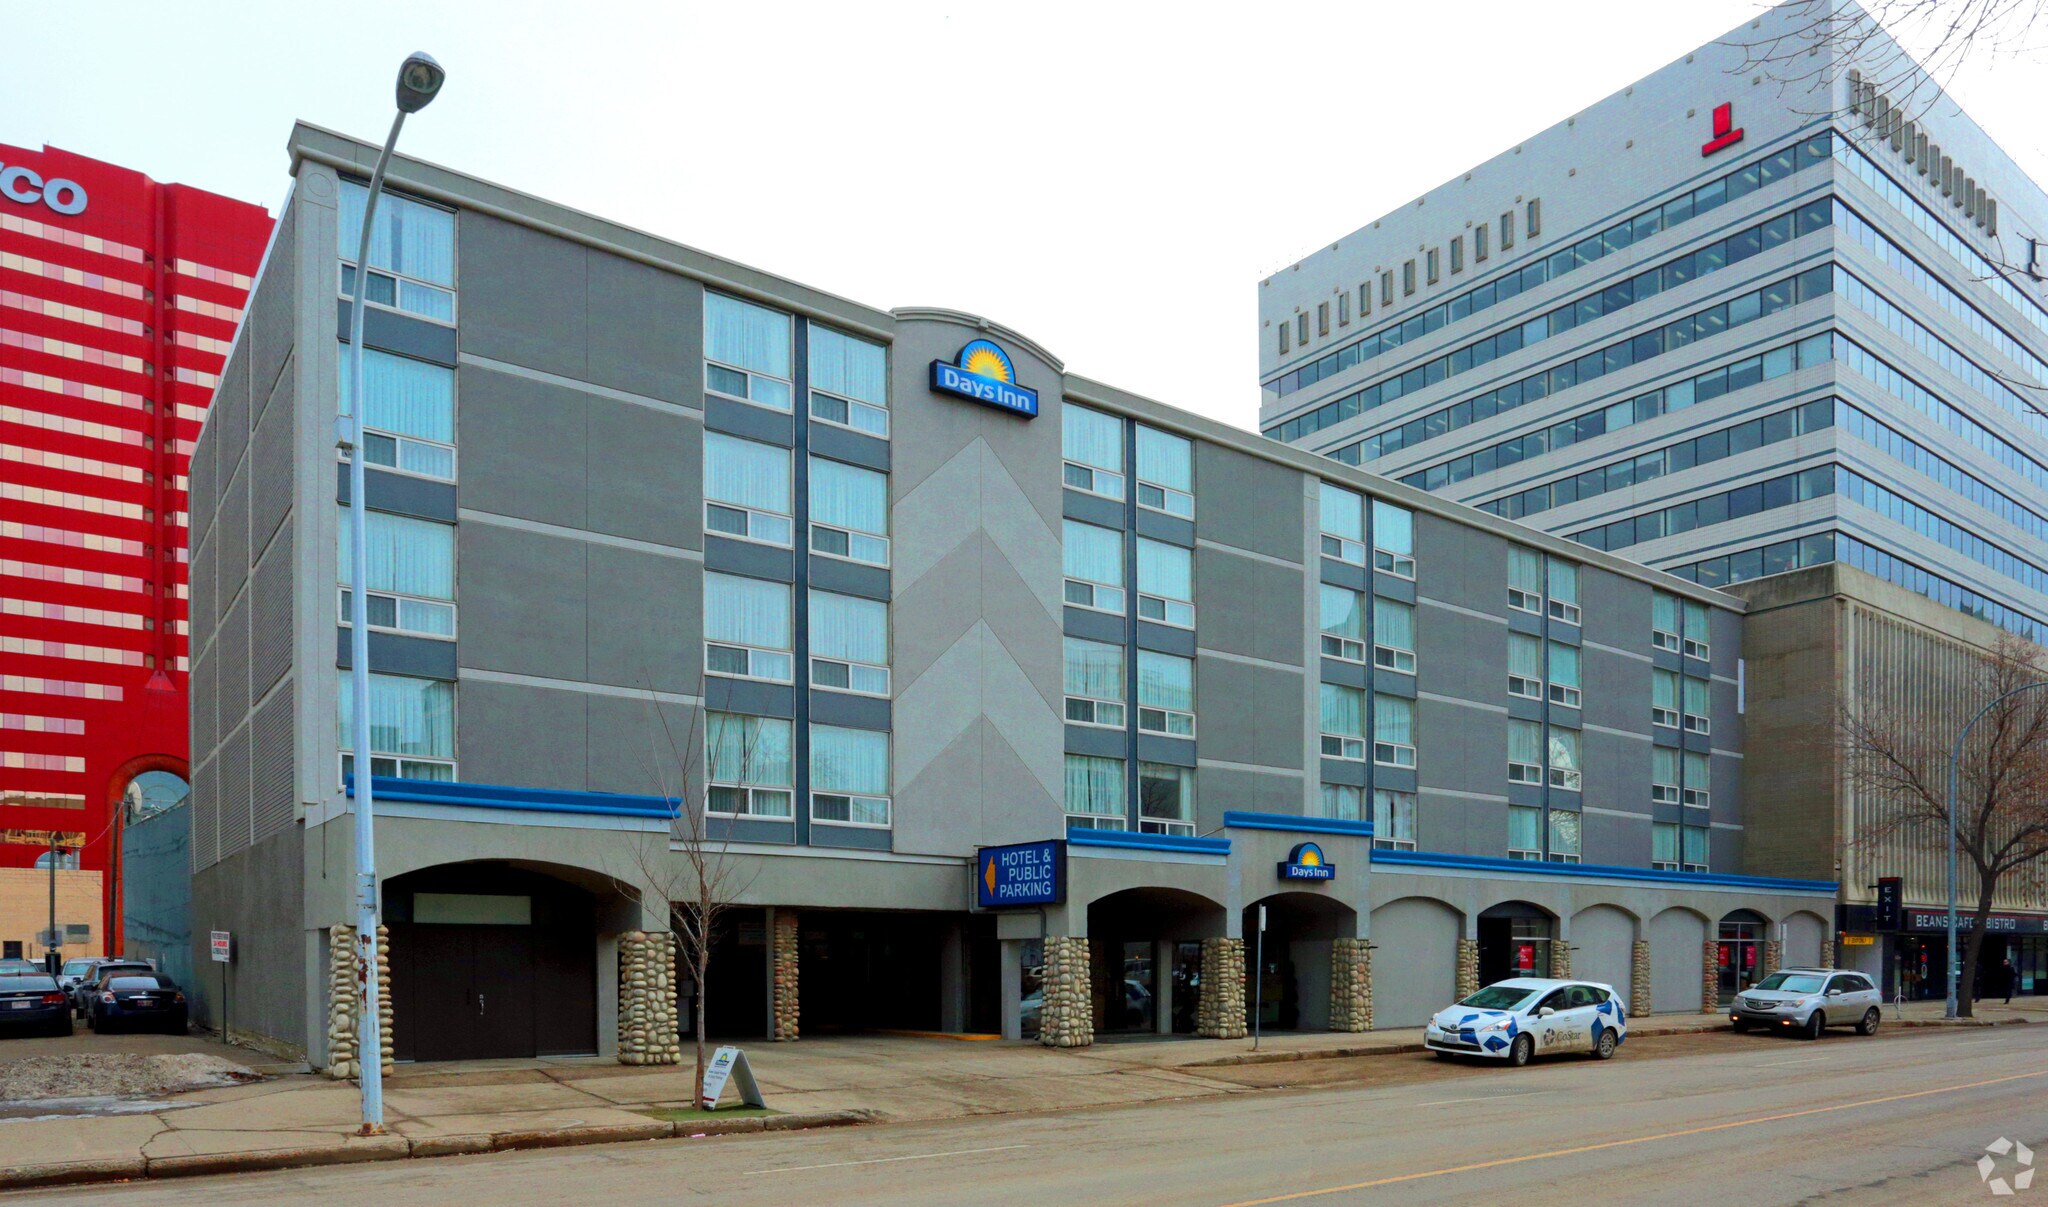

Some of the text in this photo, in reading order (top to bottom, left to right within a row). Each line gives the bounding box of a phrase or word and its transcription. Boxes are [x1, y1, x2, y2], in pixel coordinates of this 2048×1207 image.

[0, 161, 88, 215] CO
[944, 368, 1030, 410] Days Inn
[1001, 848, 1052, 866] HOTEL &
[1008, 865, 1051, 881] PUBLIC
[1291, 866, 1329, 878] Days Inn
[1000, 881, 1052, 898] PARKING
[1883, 886, 1892, 922] EXIT
[1916, 914, 1949, 928] BEANS
[1986, 917, 2016, 929] BISTRO
[1556, 1030, 1582, 1042] CoStar
